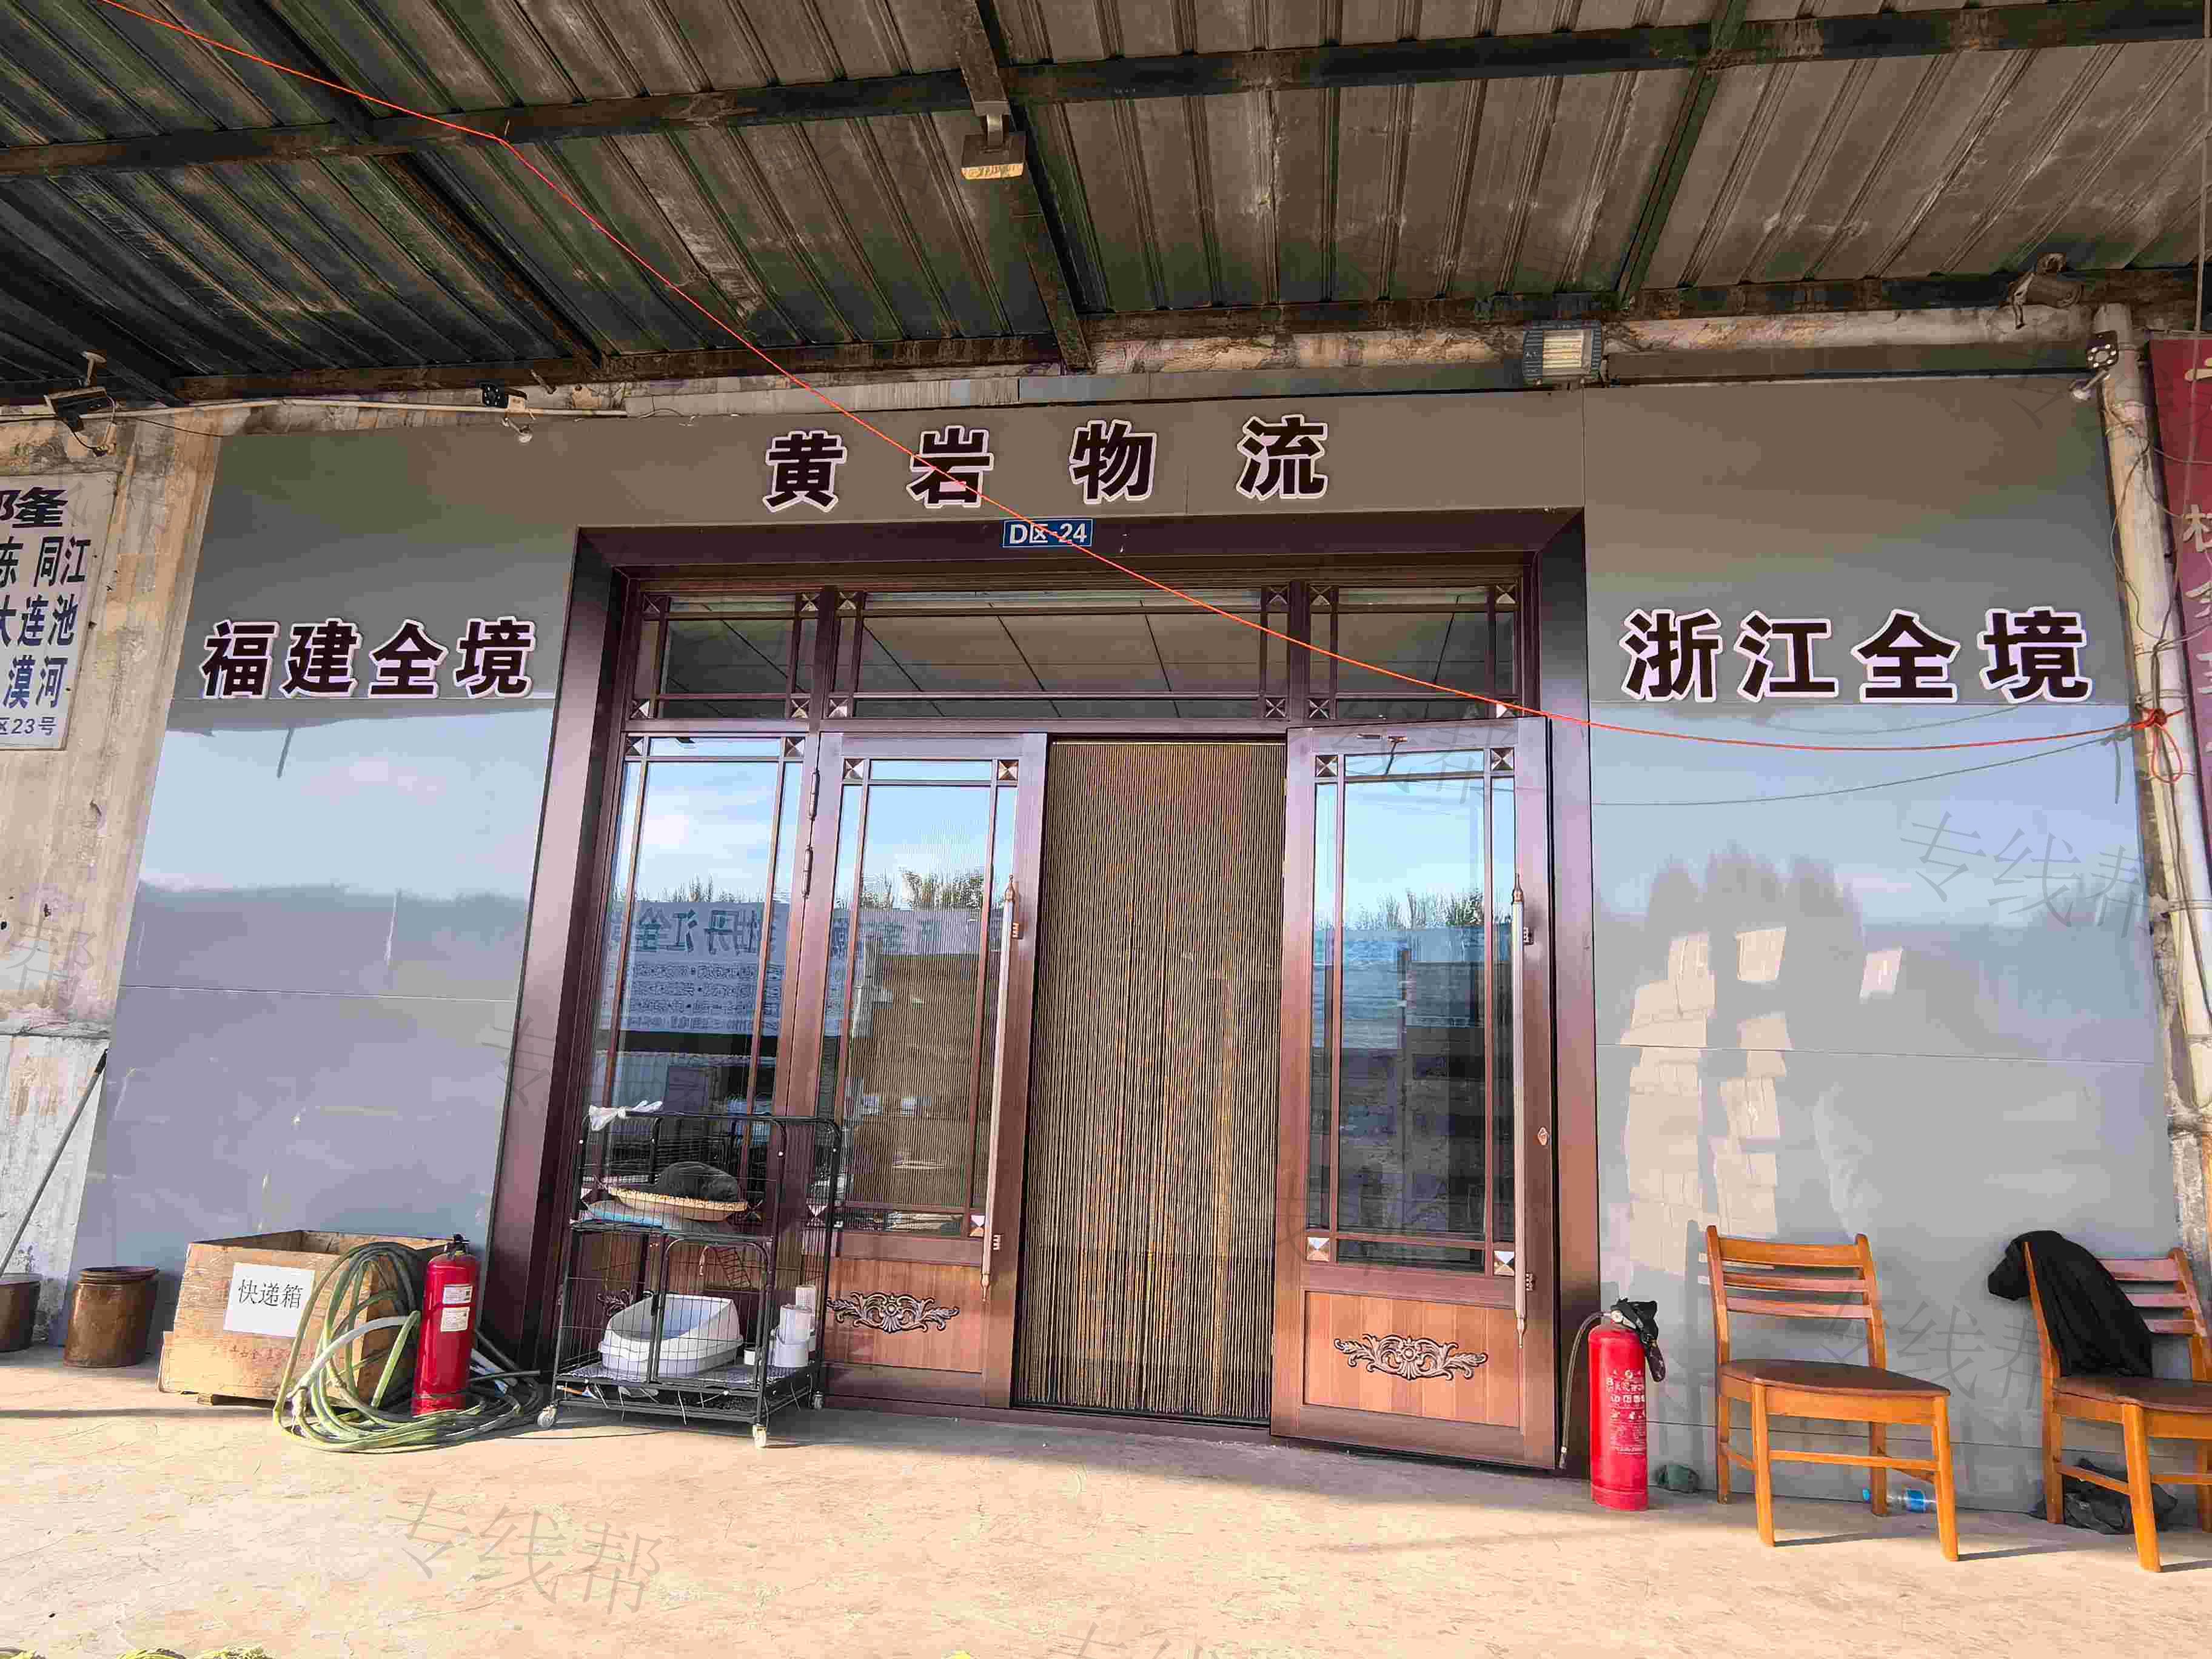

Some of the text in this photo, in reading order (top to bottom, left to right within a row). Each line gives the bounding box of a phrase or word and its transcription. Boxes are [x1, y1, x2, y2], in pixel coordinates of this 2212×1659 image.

[762, 414, 1328, 512] 黄岩物流
[33, 536, 92, 587] 同江
[3, 655, 68, 708] 漠河
[199, 616, 537, 699] 福建全境
[1619, 606, 2091, 703] 浙江全境
[238, 1279, 303, 1309] 快递箱
